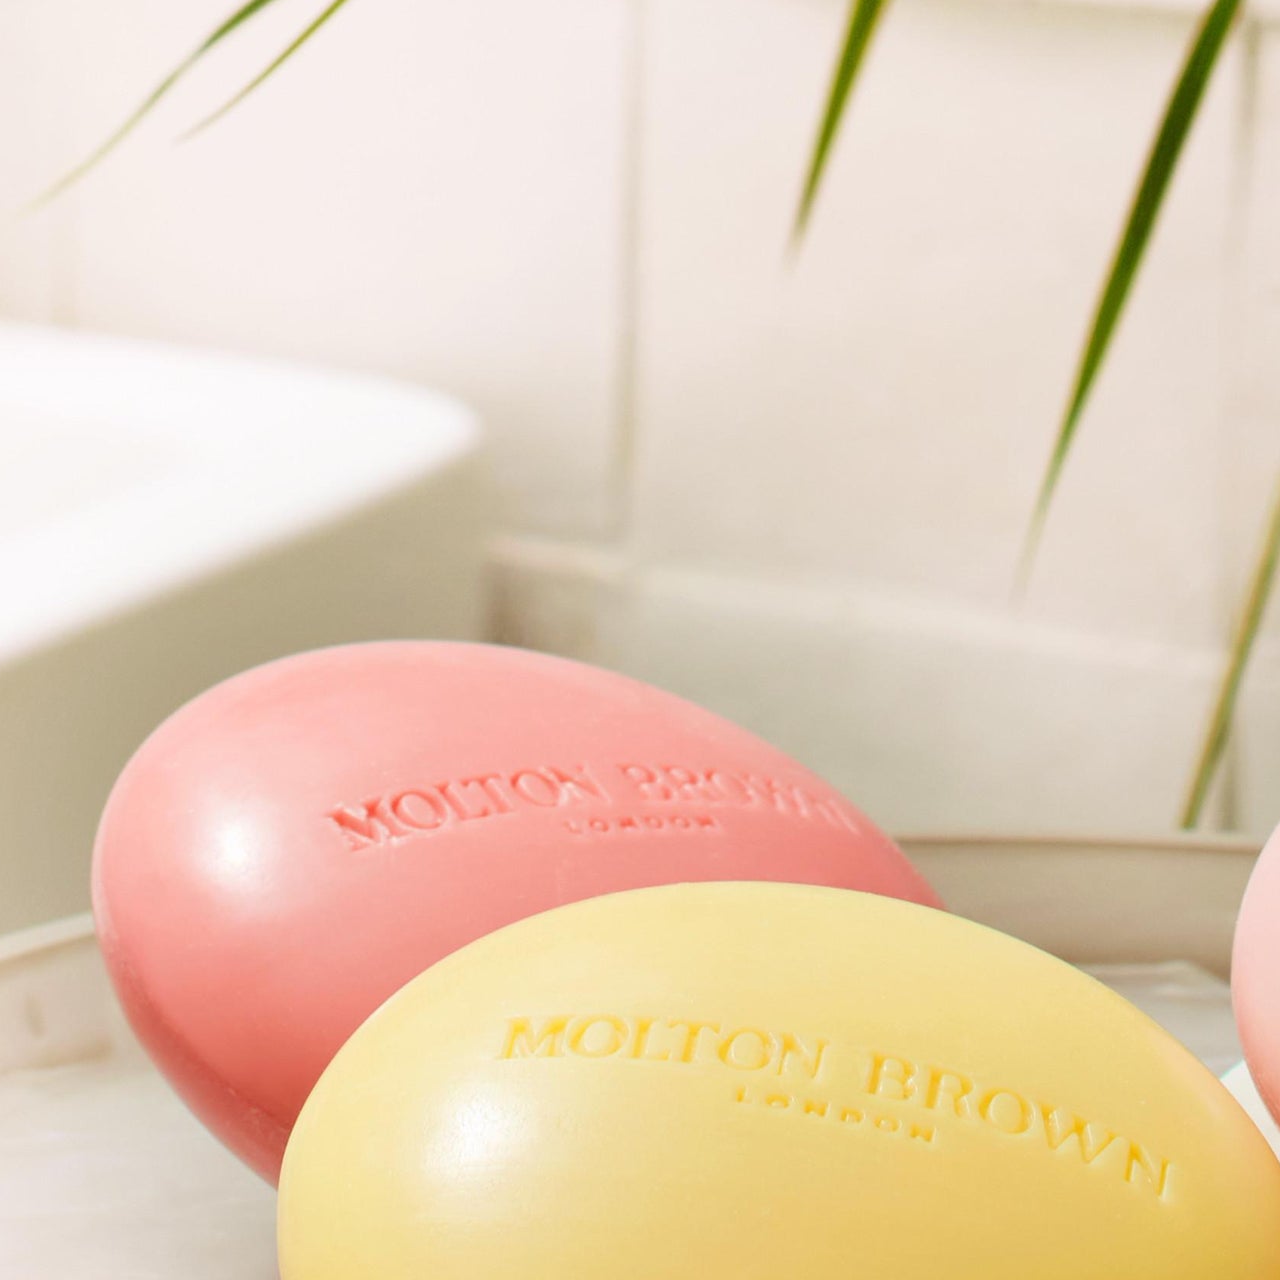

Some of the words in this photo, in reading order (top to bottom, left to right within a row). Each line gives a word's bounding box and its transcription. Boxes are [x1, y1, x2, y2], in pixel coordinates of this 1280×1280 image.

[326, 763, 611, 852] MOLTON
[616, 762, 864, 834] BROWN
[564, 814, 718, 834] LONDON
[497, 1015, 829, 1079] MOLTON
[865, 1049, 1173, 1200] BROWN
[735, 1085, 939, 1143] LONDON
